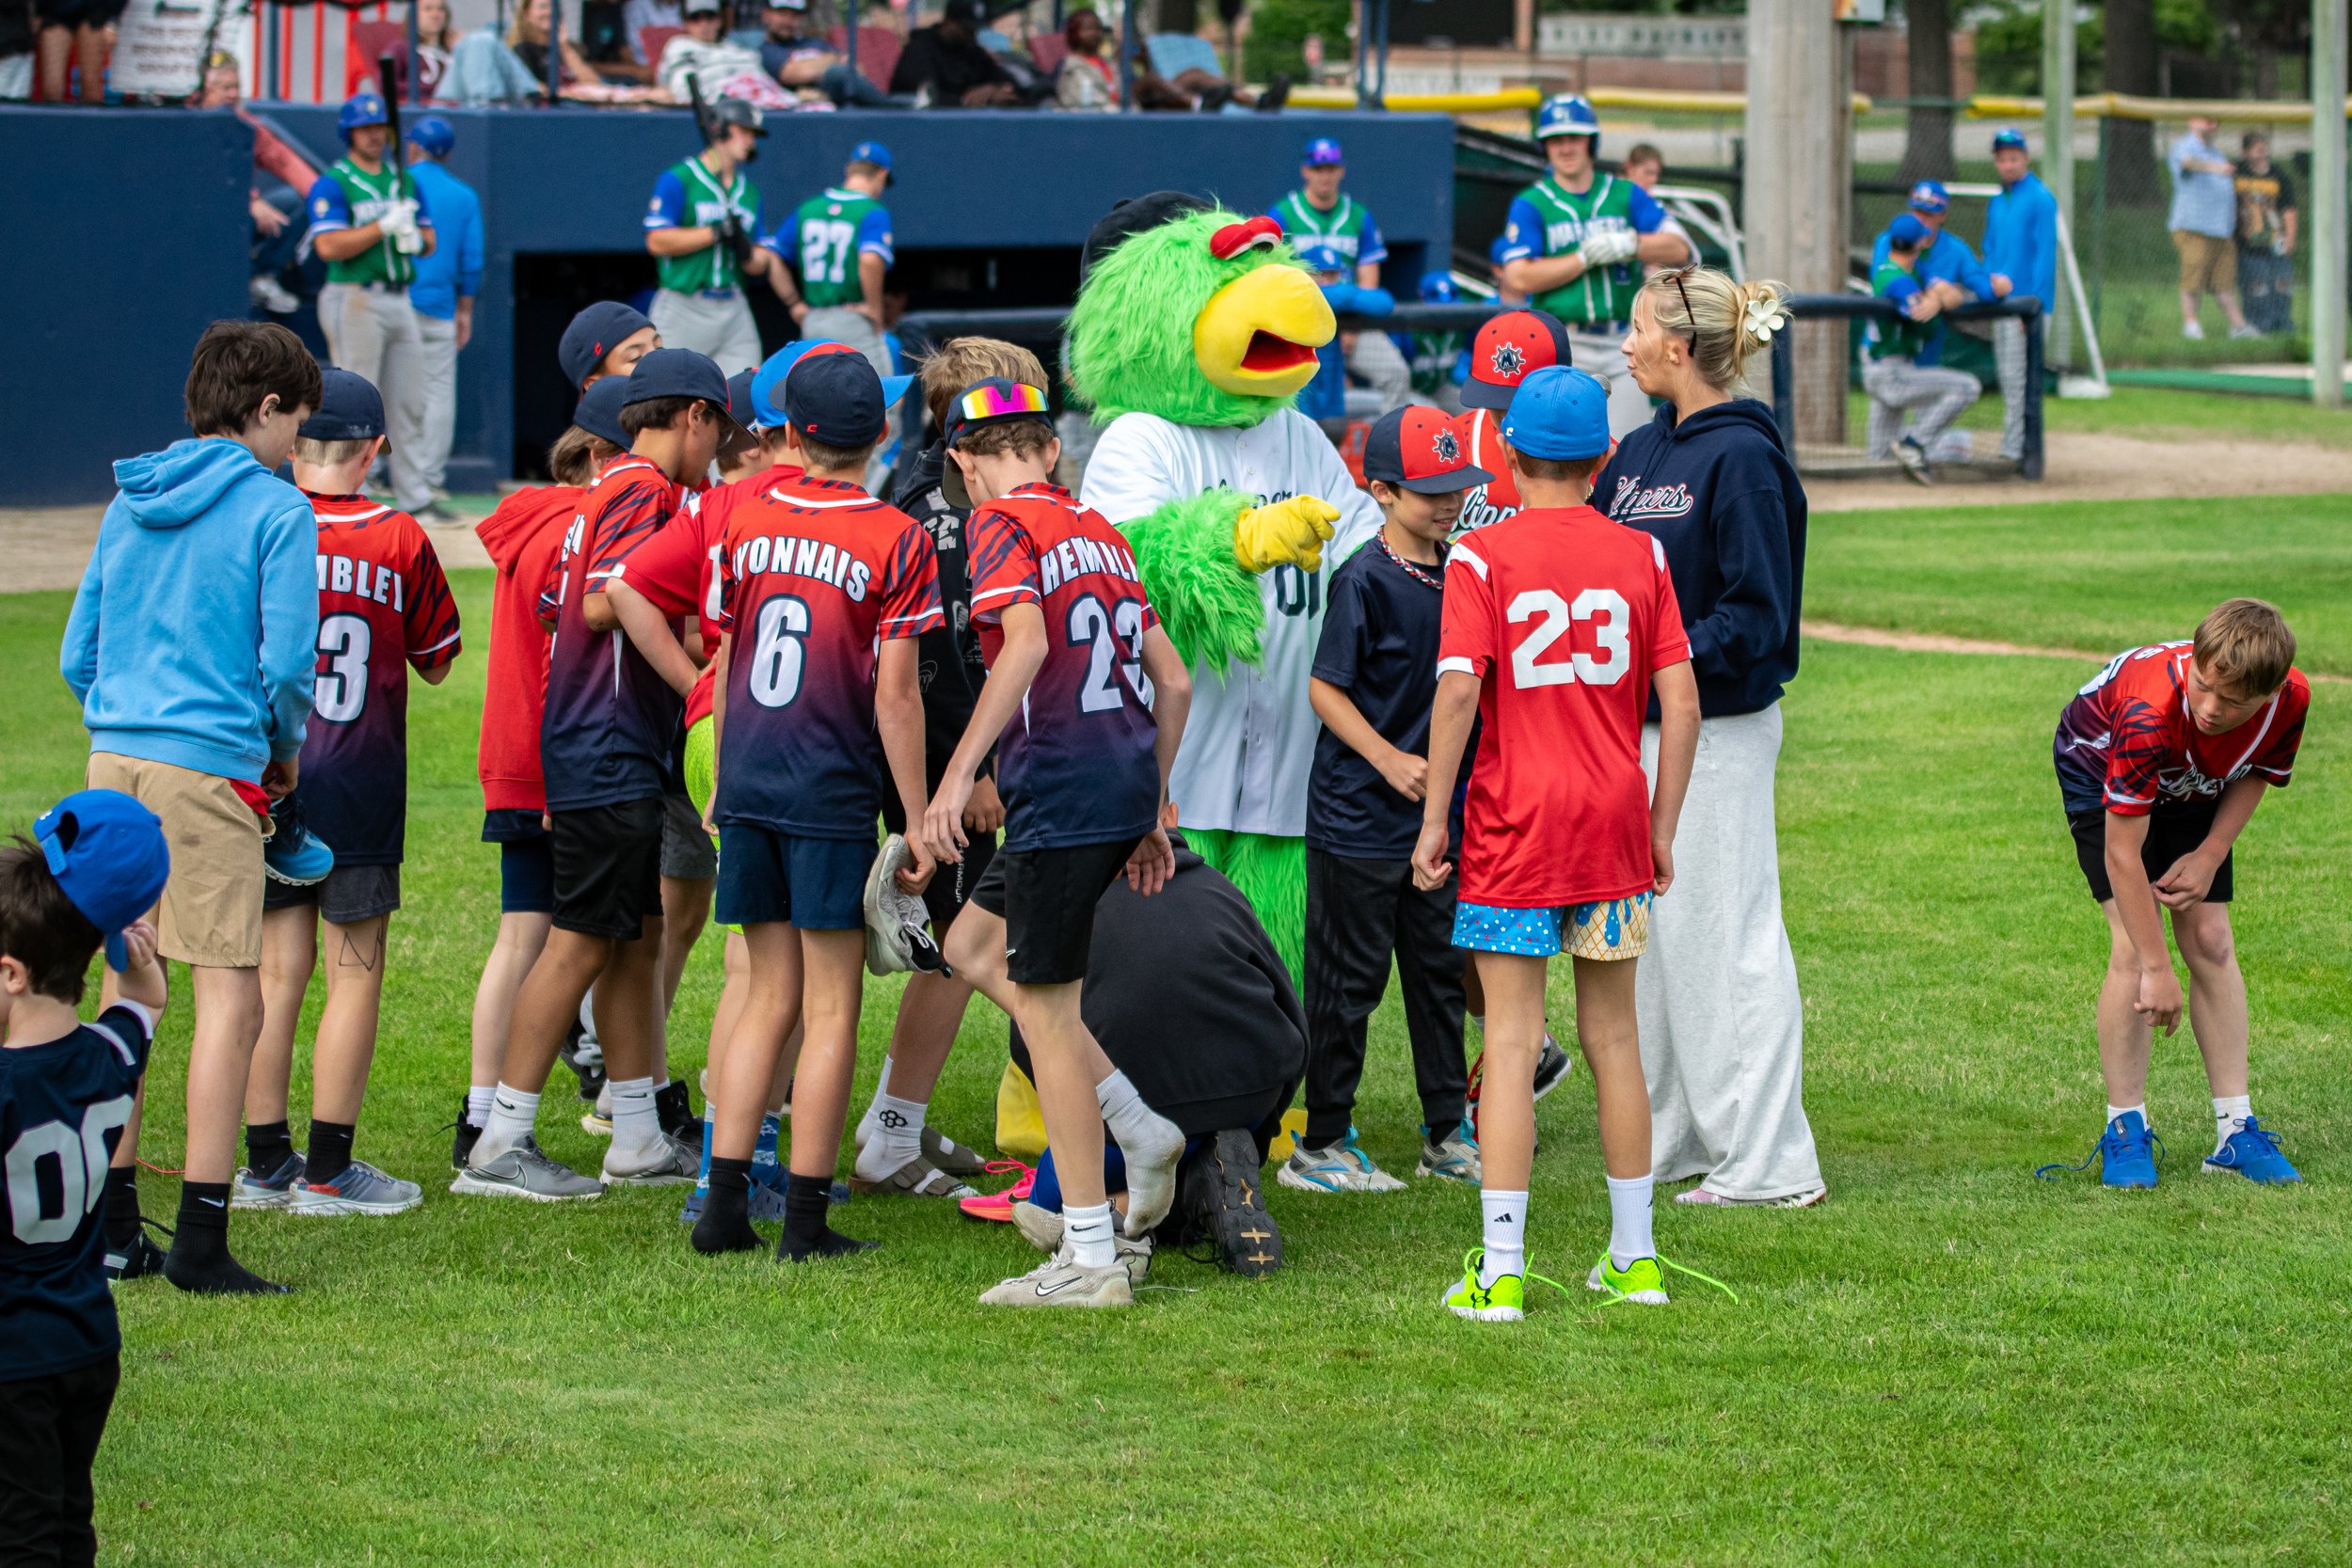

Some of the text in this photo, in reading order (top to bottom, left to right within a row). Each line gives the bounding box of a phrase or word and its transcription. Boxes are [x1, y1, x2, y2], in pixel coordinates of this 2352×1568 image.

[802, 218, 854, 283] 27
[732, 534, 871, 603] YONNAIS
[749, 596, 810, 709] 6
[1068, 594, 1155, 713] 23
[1506, 588, 1630, 689] 23
